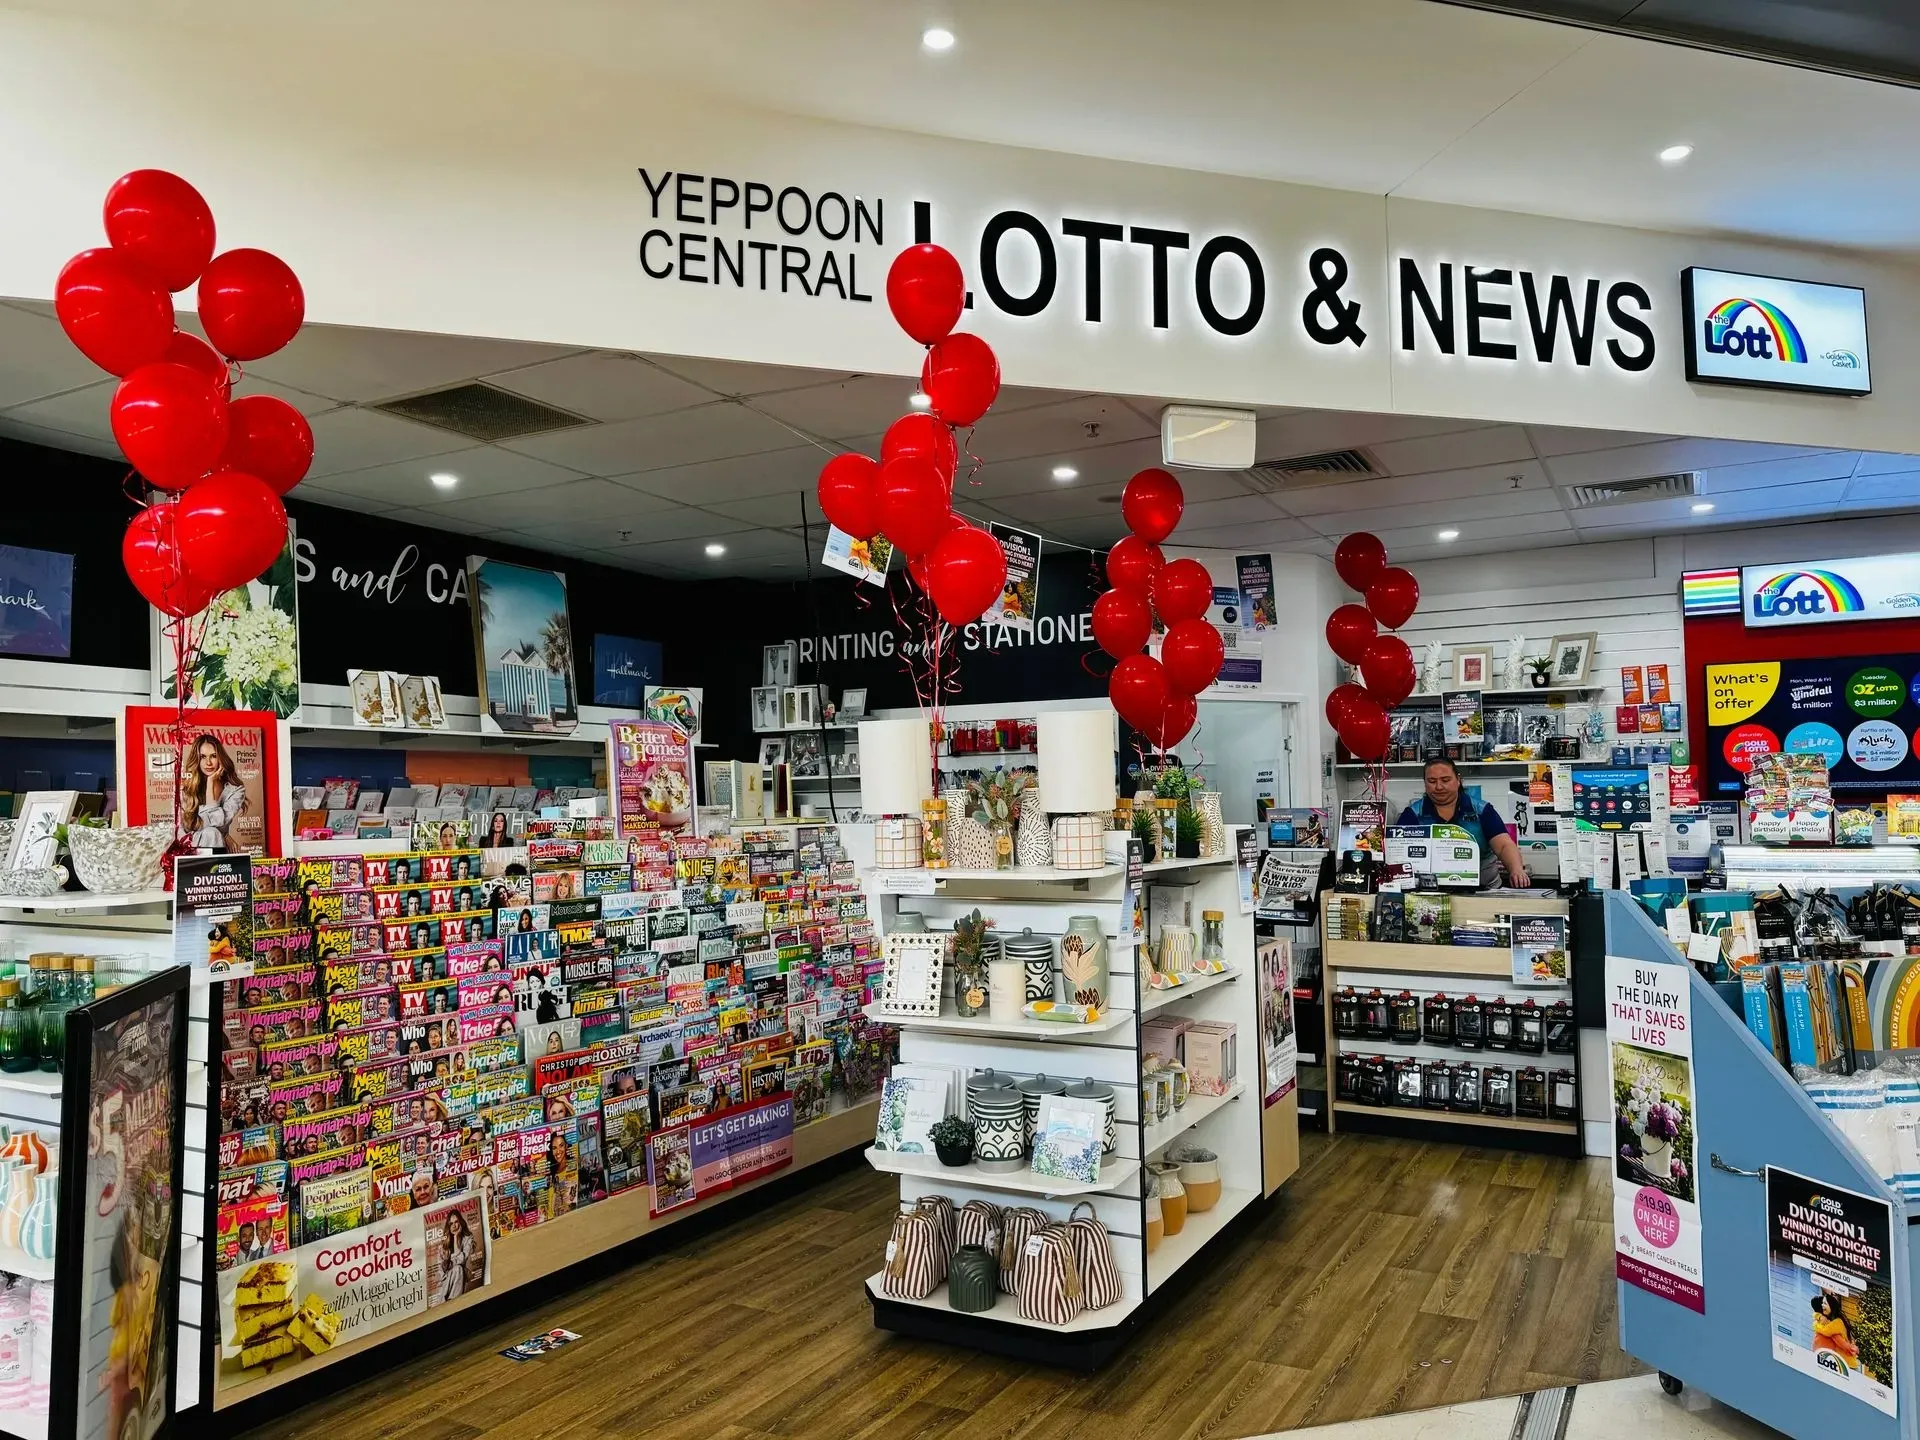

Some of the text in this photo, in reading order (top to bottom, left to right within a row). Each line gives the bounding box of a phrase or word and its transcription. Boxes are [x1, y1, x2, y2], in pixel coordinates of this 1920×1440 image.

[637, 168, 883, 245] YEPPOON
[640, 229, 872, 303] CENTRAL
[1302, 247, 1367, 348] &
[1400, 257, 1656, 371] NEWS
[1714, 315, 1729, 324] the
[1704, 319, 1772, 359] Lott
[1826, 352, 1847, 360] Golden
[332, 544, 419, 604] and
[1753, 589, 1826, 618] Lott
[607, 663, 652, 679] Hallmark
[1714, 673, 1769, 684] What's
[1714, 688, 1734, 697] on
[1790, 686, 1833, 701] Windfall
[1876, 684, 1898, 692] LOTTO
[1714, 699, 1754, 709] offer
[1867, 698, 1897, 706] million
[211, 728, 261, 750] Weekly
[619, 725, 668, 745] Better
[632, 743, 685, 762] Homes
[236, 757, 255, 765] Harry
[182, 772, 193, 780] up
[623, 814, 647, 822] SPRING
[623, 821, 660, 829] MAKEOVERS
[1758, 821, 1781, 829] Happy
[1796, 821, 1820, 829] Happy
[630, 843, 658, 852] Better
[671, 841, 695, 851] Better
[299, 861, 332, 876] New
[367, 862, 386, 876] TV
[633, 869, 658, 879] Better
[193, 874, 237, 886] DIVISION
[1261, 878, 1304, 889] OUR KIDS
[1271, 873, 1289, 882] WIN
[1290, 875, 1307, 883] FOR
[184, 883, 248, 895] WINNING SYNDICATE
[187, 891, 247, 902] ENTRY SOLD HERE!
[309, 895, 342, 909] New
[377, 893, 398, 908] TV
[652, 916, 685, 930] Wellness
[317, 929, 351, 944] New
[387, 926, 407, 941] TV
[744, 952, 778, 965] WINERIES
[390, 959, 411, 975] TV
[565, 958, 613, 979] MUSCLE CAR
[296, 969, 318, 986] Day
[1635, 969, 1658, 987] BUY
[754, 981, 769, 991] which
[682, 1000, 703, 1009] Cross
[1617, 985, 1679, 1010] THE DIARY
[300, 1003, 322, 1022] Day
[1612, 1003, 1686, 1031] THAT SAVES
[759, 1019, 784, 1033] Ships
[1892, 998, 1903, 1047] KINDNESS
[402, 1025, 426, 1041] Who
[1631, 1026, 1666, 1046] LIVES
[317, 1041, 338, 1059] Day
[410, 1060, 433, 1075] Who
[752, 1070, 785, 1089] HISTORY
[1619, 1058, 1685, 1094] Health Diary
[695, 1125, 724, 1146] LET'S
[726, 1117, 747, 1135] GET
[749, 1104, 790, 1127] BAKING!
[431, 1132, 462, 1153] chat
[521, 1133, 543, 1147] Take
[439, 1153, 494, 1179] Pick Me Up!
[376, 1173, 413, 1199] Yours
[305, 1186, 347, 1206] People's
[1821, 1196, 1841, 1208] GOLD
[1639, 1193, 1672, 1216] $19.99
[1821, 1203, 1844, 1216] LOTTO
[1637, 1208, 1675, 1233] ON SALE
[1789, 1202, 1867, 1242] DIVISION 1
[426, 1229, 444, 1242] Elle
[1644, 1225, 1668, 1245] HERE
[1778, 1214, 1880, 1259] WINNING SYNDICATE
[315, 1228, 402, 1272] Comfort
[1782, 1228, 1877, 1271] ENTRY SOLD HERE!
[335, 1248, 413, 1287] cooking
[1636, 1246, 1698, 1276] BREAST CANCER TRIALS
[1621, 1259, 1699, 1298] SUPPORT BREAST CANCER
[1642, 1276, 1675, 1296] RESEARCH
[322, 1268, 423, 1316] with Maggie Beer
[336, 1286, 424, 1333] and Ottolenghi
